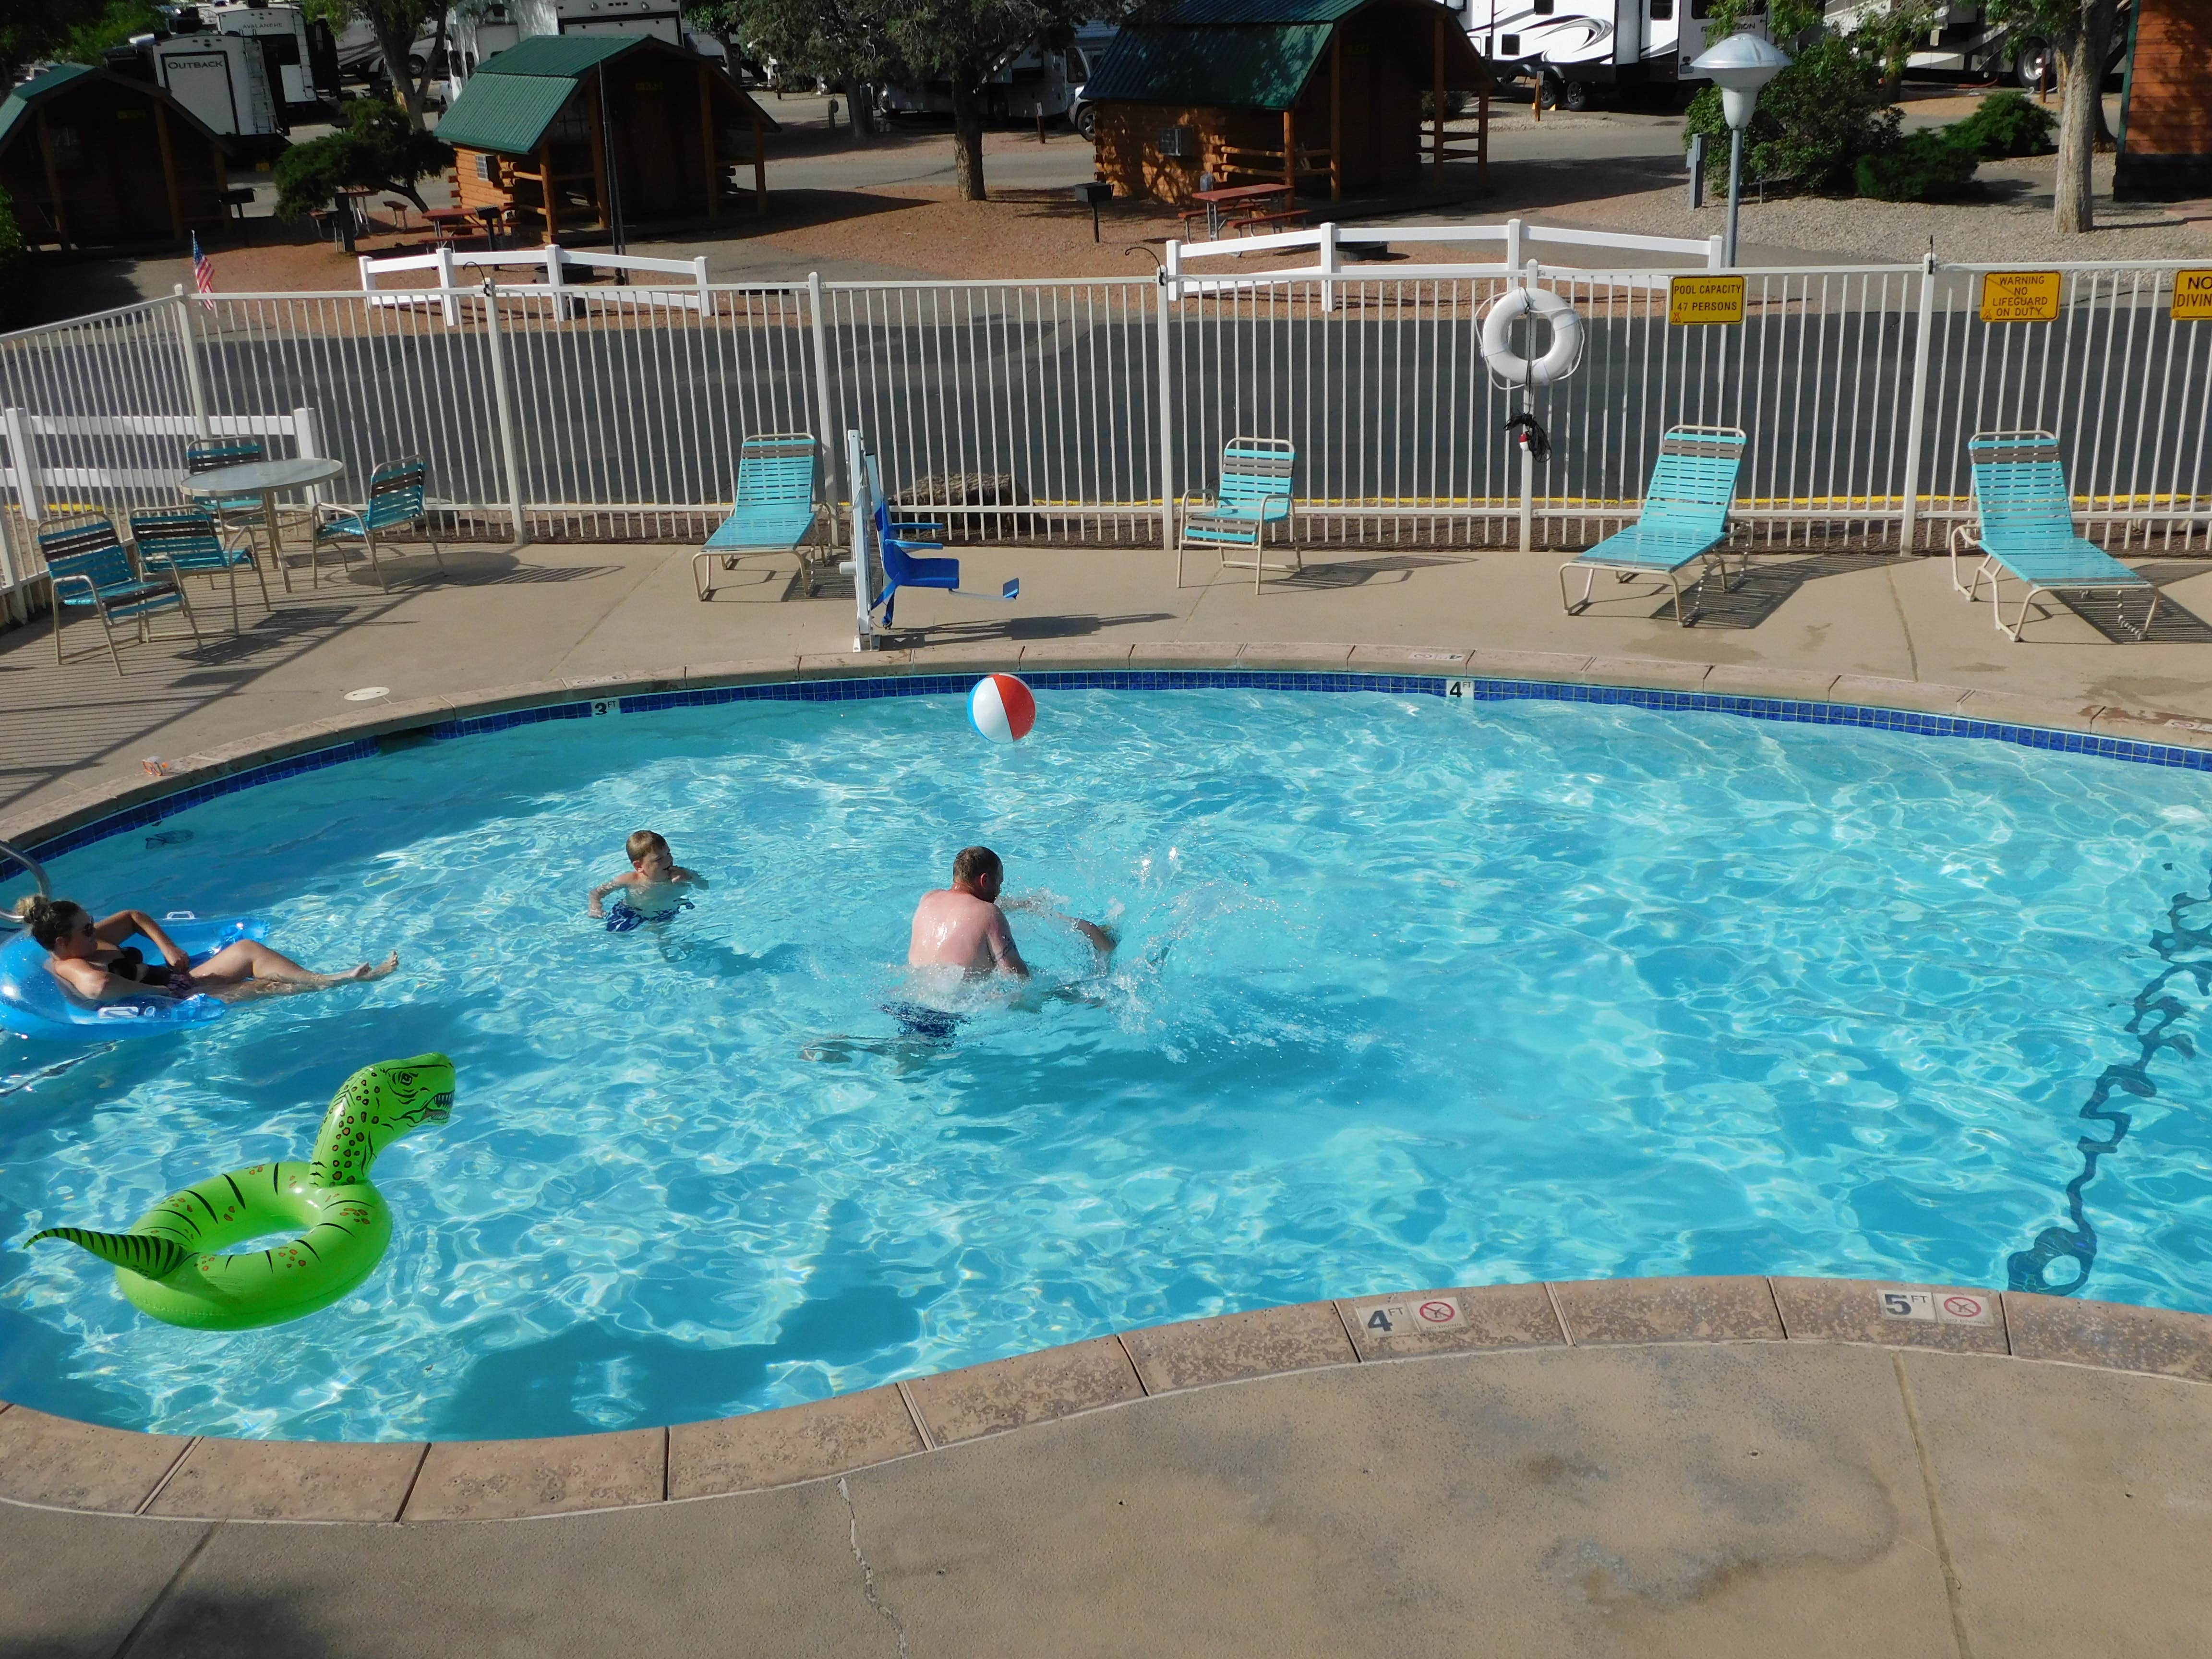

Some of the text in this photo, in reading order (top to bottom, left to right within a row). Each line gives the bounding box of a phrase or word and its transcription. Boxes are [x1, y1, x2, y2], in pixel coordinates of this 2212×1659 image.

[168, 61, 223, 70] OUTBACK
[2000, 276, 2044, 285] WARNING
[2188, 276, 2212, 289] NO
[1674, 284, 1741, 294] POOL CAPACITY
[2014, 287, 2028, 295] NO
[1993, 297, 2048, 306] LIFEGUARD
[1677, 302, 1737, 311] 47 PERSONS
[1996, 307, 2042, 316] ON DUTY
[1450, 681, 1463, 697] 4
[595, 702, 607, 715] 3
[1884, 1294, 1927, 1316] 5 FT
[1367, 1307, 1403, 1332] 4 FT
